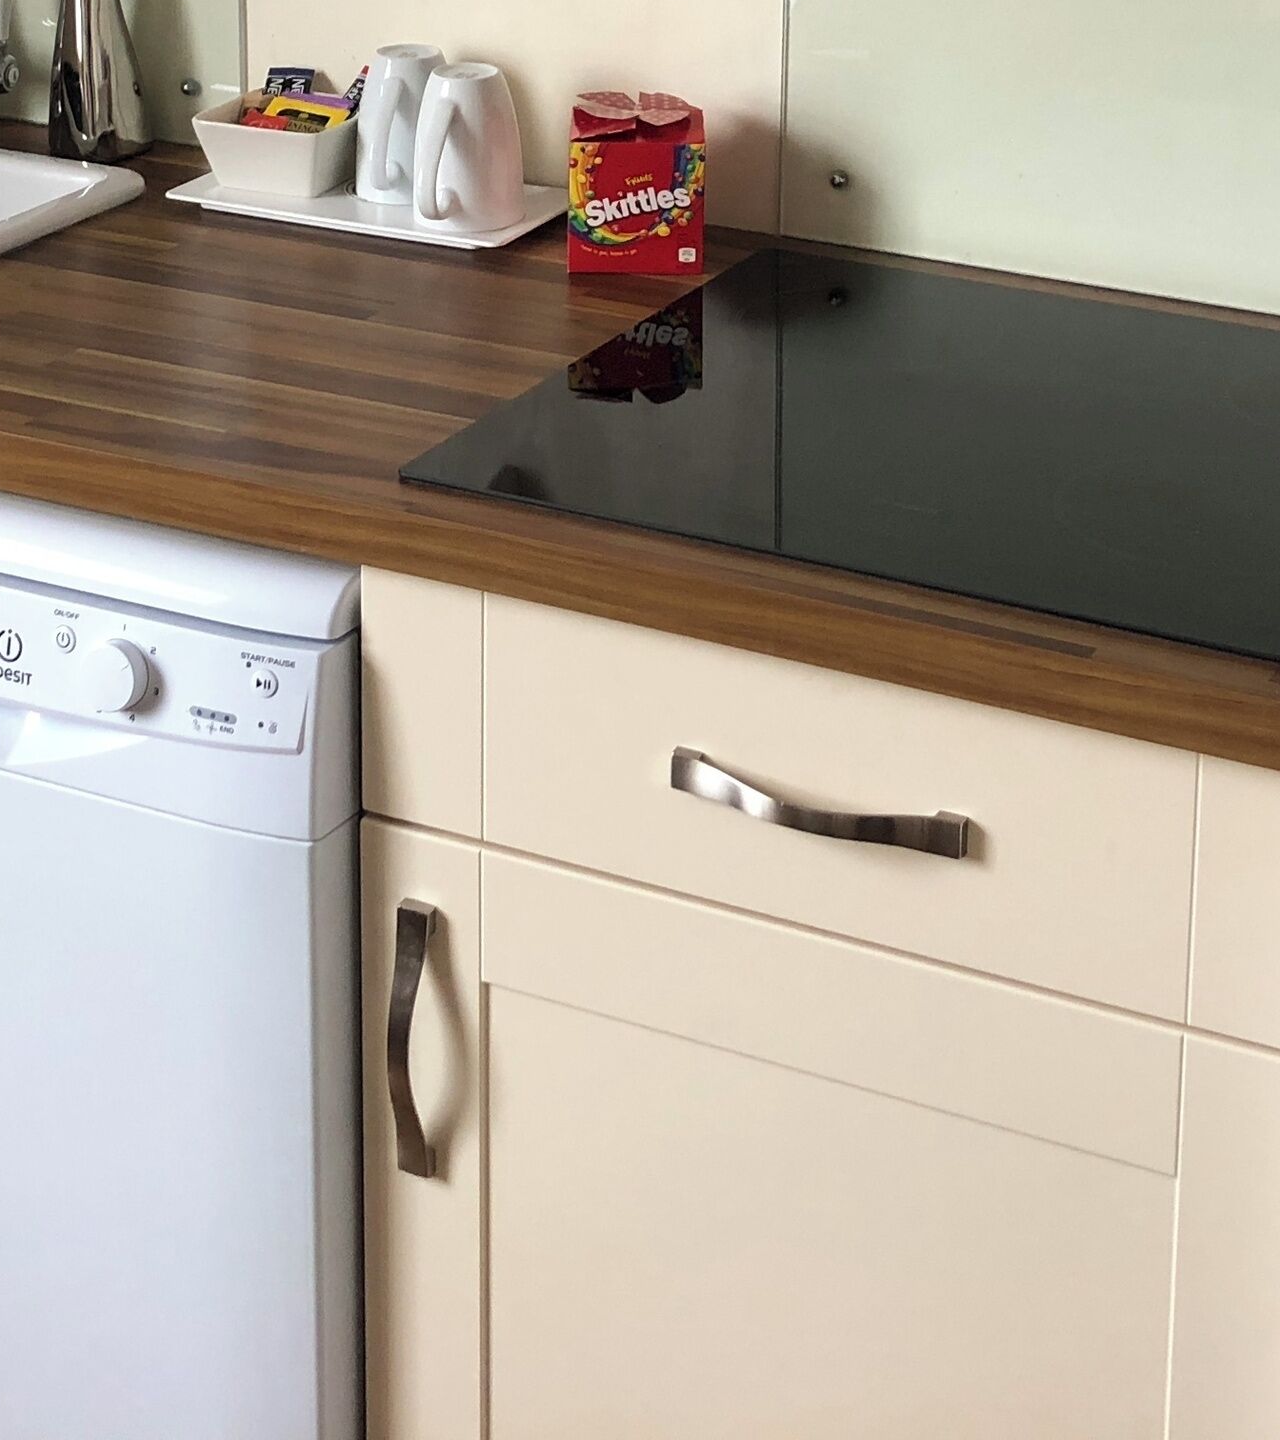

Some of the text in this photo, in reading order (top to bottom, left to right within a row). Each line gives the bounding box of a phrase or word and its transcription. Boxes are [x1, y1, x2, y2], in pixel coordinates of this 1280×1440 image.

[584, 187, 691, 227] Skittles
[150, 646, 157, 655] 2
[241, 651, 296, 669] START/PAUSE
[153, 686, 160, 696] 3
[129, 714, 135, 723] 4
